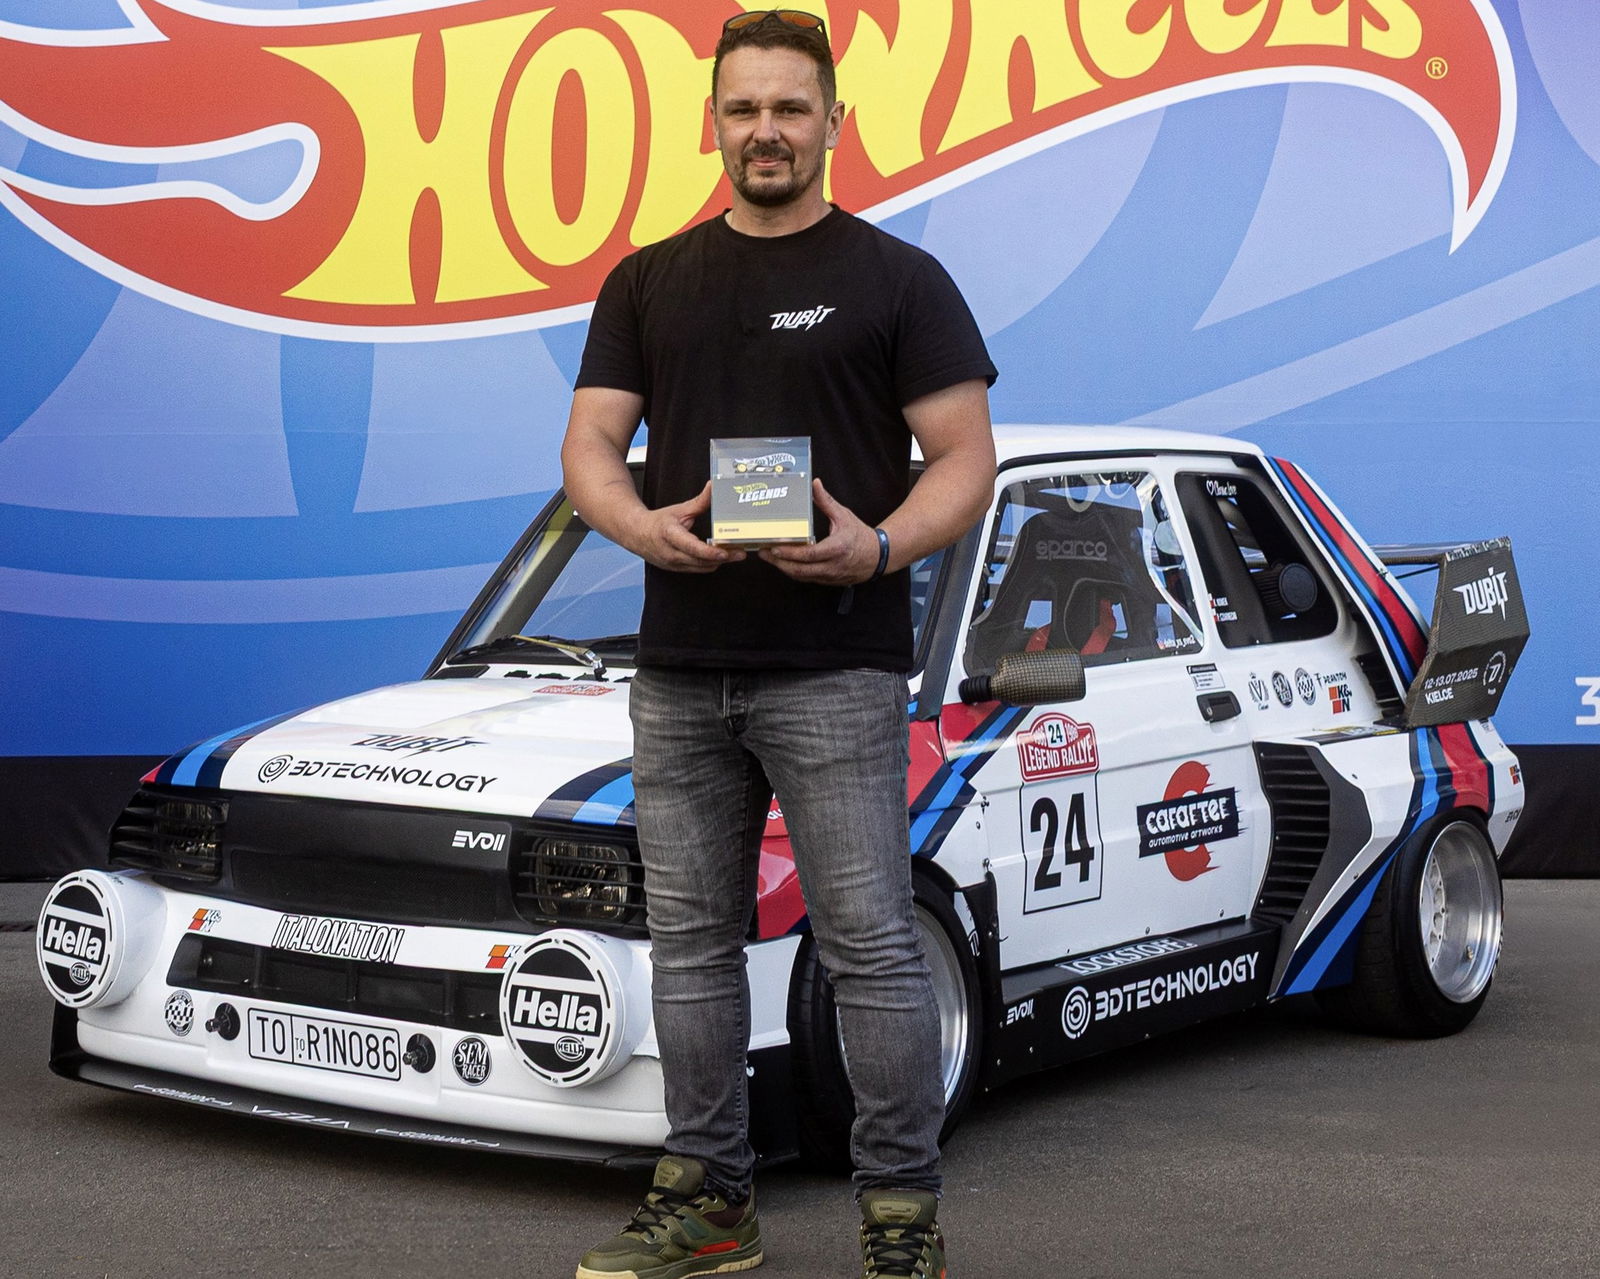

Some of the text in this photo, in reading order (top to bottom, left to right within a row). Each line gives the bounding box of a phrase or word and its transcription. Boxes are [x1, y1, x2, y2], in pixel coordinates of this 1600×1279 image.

[738, 486, 789, 503] LEGENDS
[1036, 540, 1107, 560] sparco
[1424, 668, 1478, 688] 12-13.07.2025
[1425, 687, 1454, 704] KIELCE
[1048, 724, 1063, 744] 24
[1024, 744, 1060, 772] LEGEND
[1061, 733, 1095, 767] RALLYE
[1030, 792, 1095, 892] 24
[1148, 824, 1223, 848] automotive artworks
[44, 918, 102, 961] Hella
[271, 914, 405, 963] ITALONATION
[513, 988, 598, 1033] Hella
[256, 1016, 286, 1055] TO
[557, 1042, 584, 1055] HELLA
[462, 1064, 486, 1079] RACER
